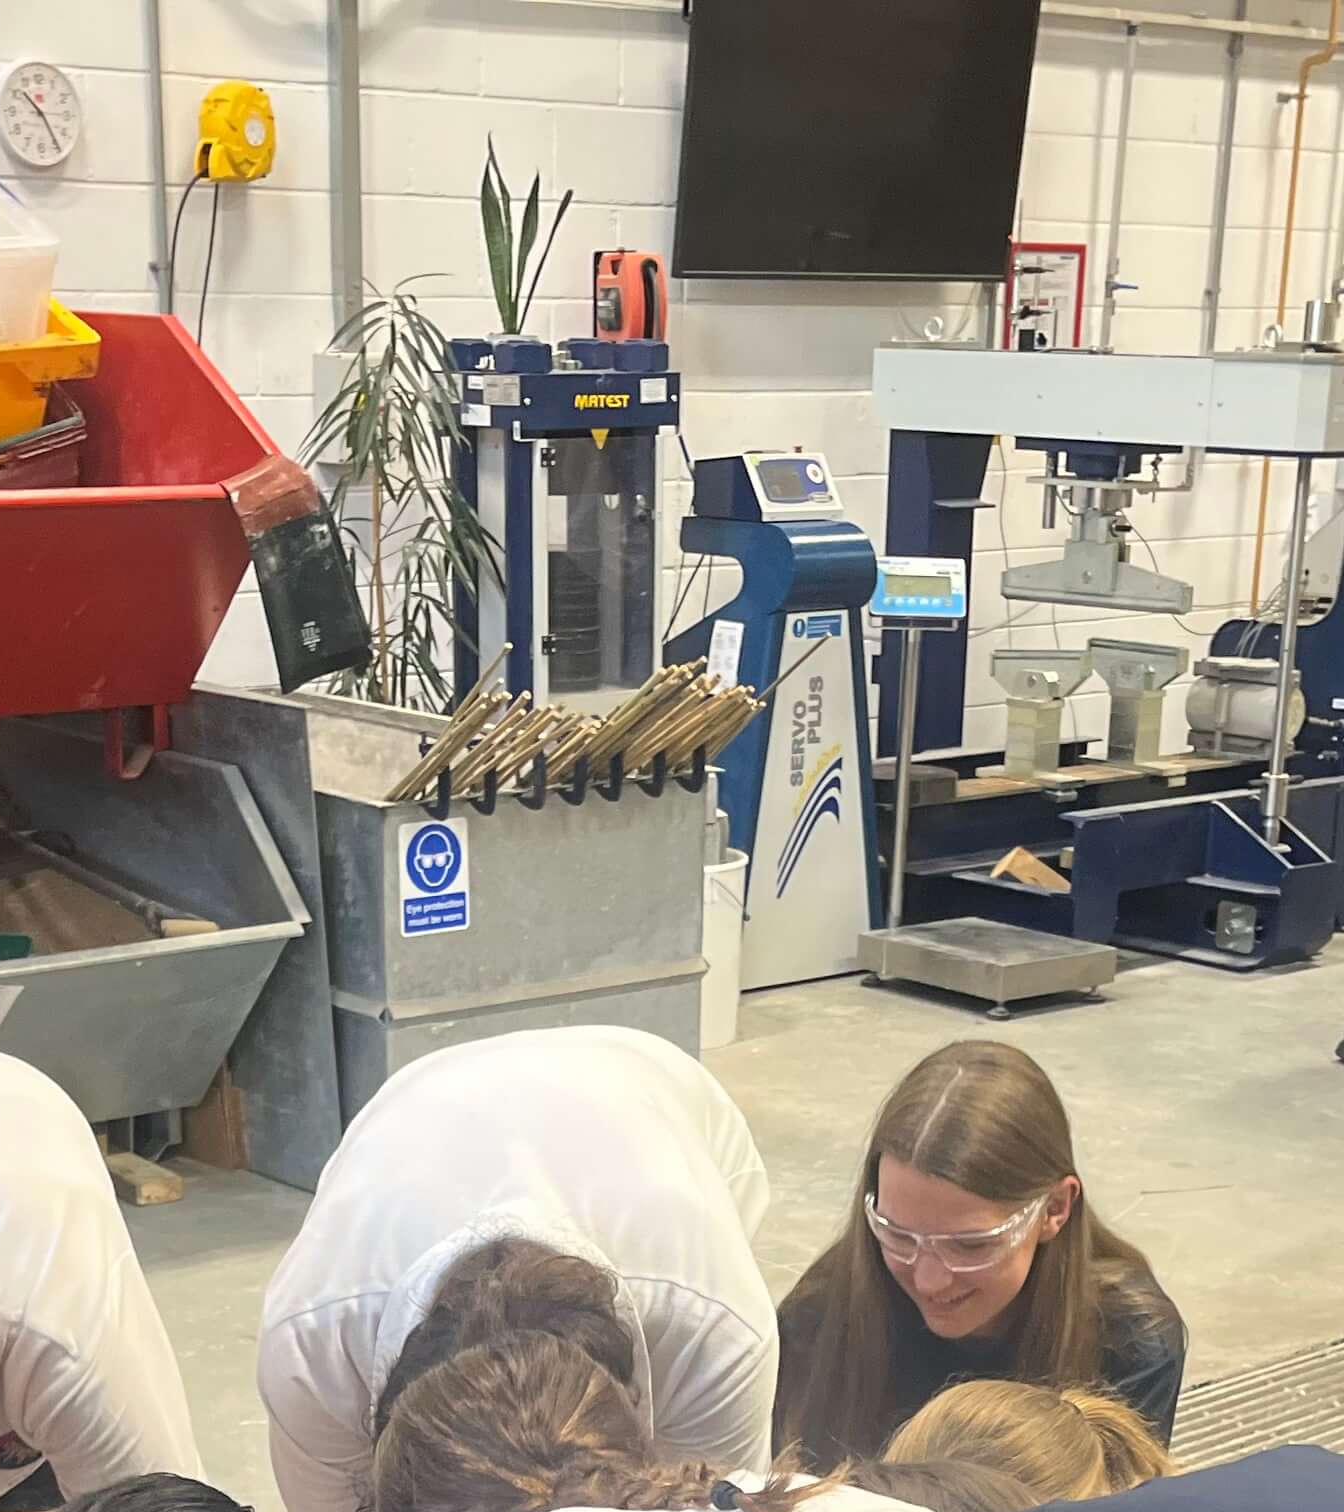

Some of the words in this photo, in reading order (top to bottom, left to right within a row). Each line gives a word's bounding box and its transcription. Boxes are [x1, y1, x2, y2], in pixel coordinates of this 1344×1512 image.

[574, 394, 630, 410] MATEST
[807, 675, 824, 744] PLUS
[790, 700, 807, 788] SERVO
[406, 904, 423, 916] Eye
[423, 900, 465, 914] protection
[407, 916, 430, 927] must
